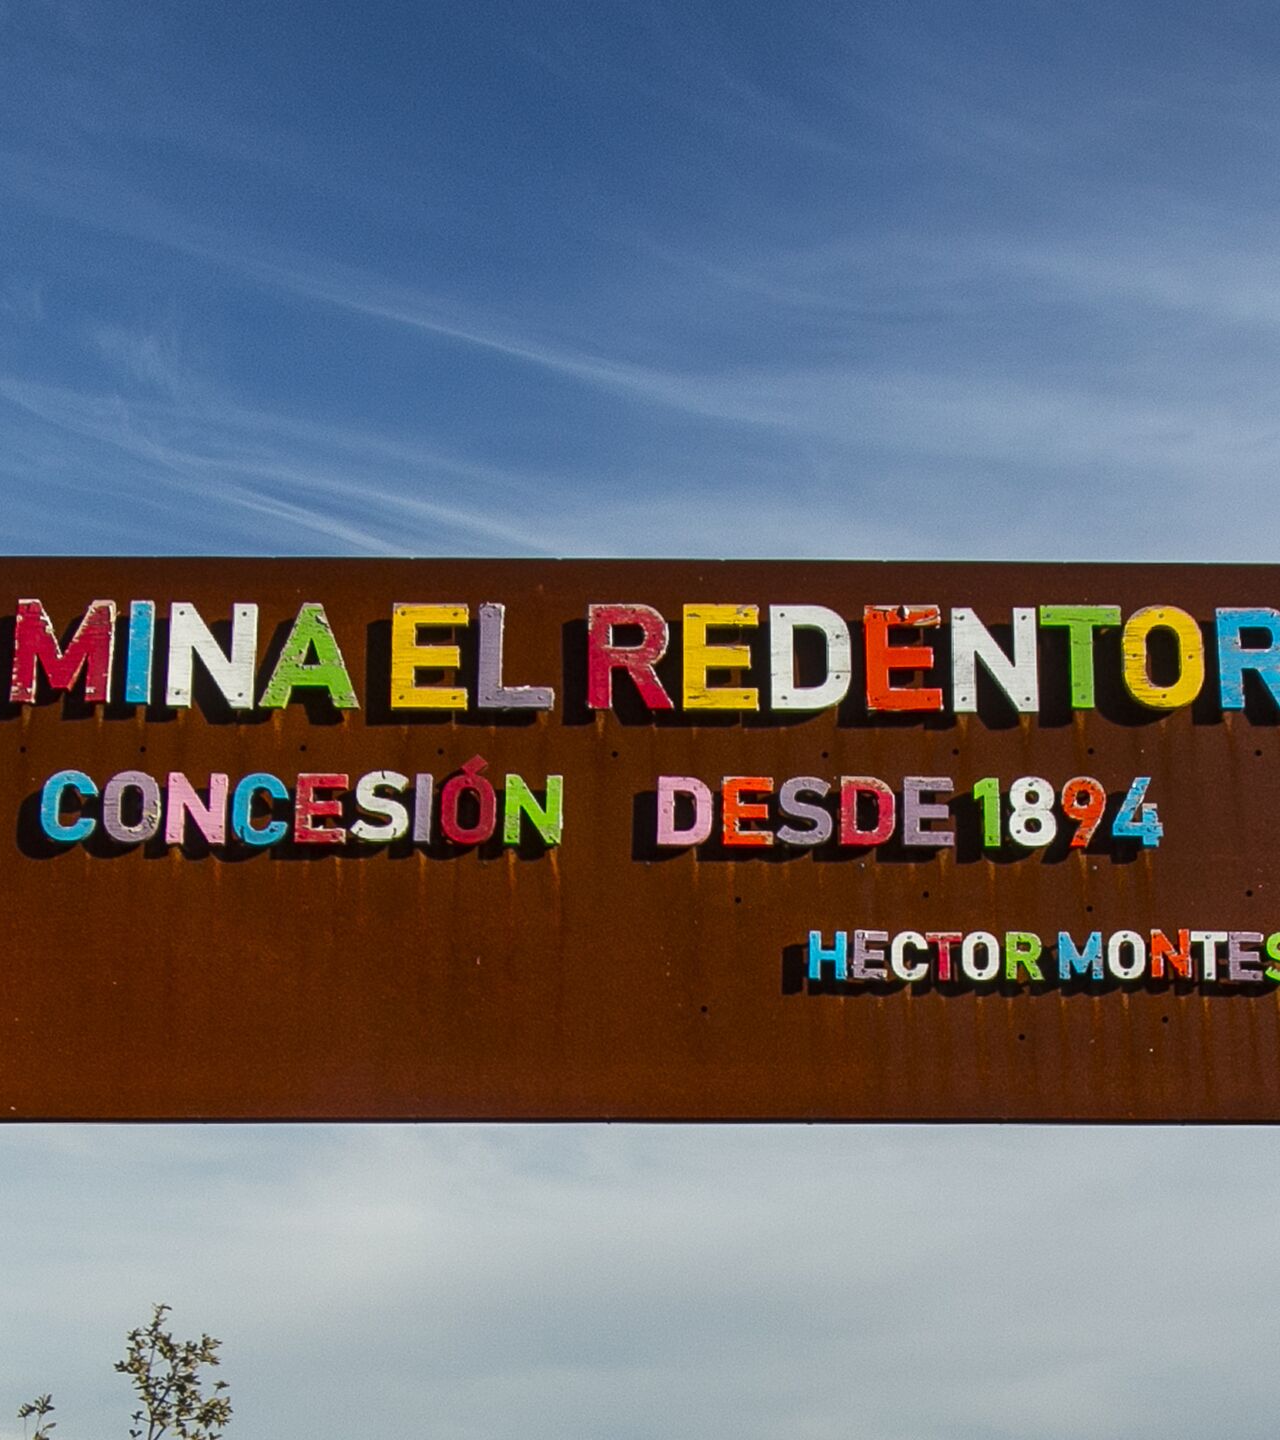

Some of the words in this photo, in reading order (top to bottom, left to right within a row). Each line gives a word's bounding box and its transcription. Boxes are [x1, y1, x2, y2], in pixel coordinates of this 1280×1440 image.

[10, 598, 361, 710] MINA
[391, 602, 556, 711] EL
[40, 754, 564, 847] CONCESIÓN
[656, 775, 956, 848] DESDE
[972, 776, 1164, 849] 1894
[808, 930, 1046, 981] HECTOR
